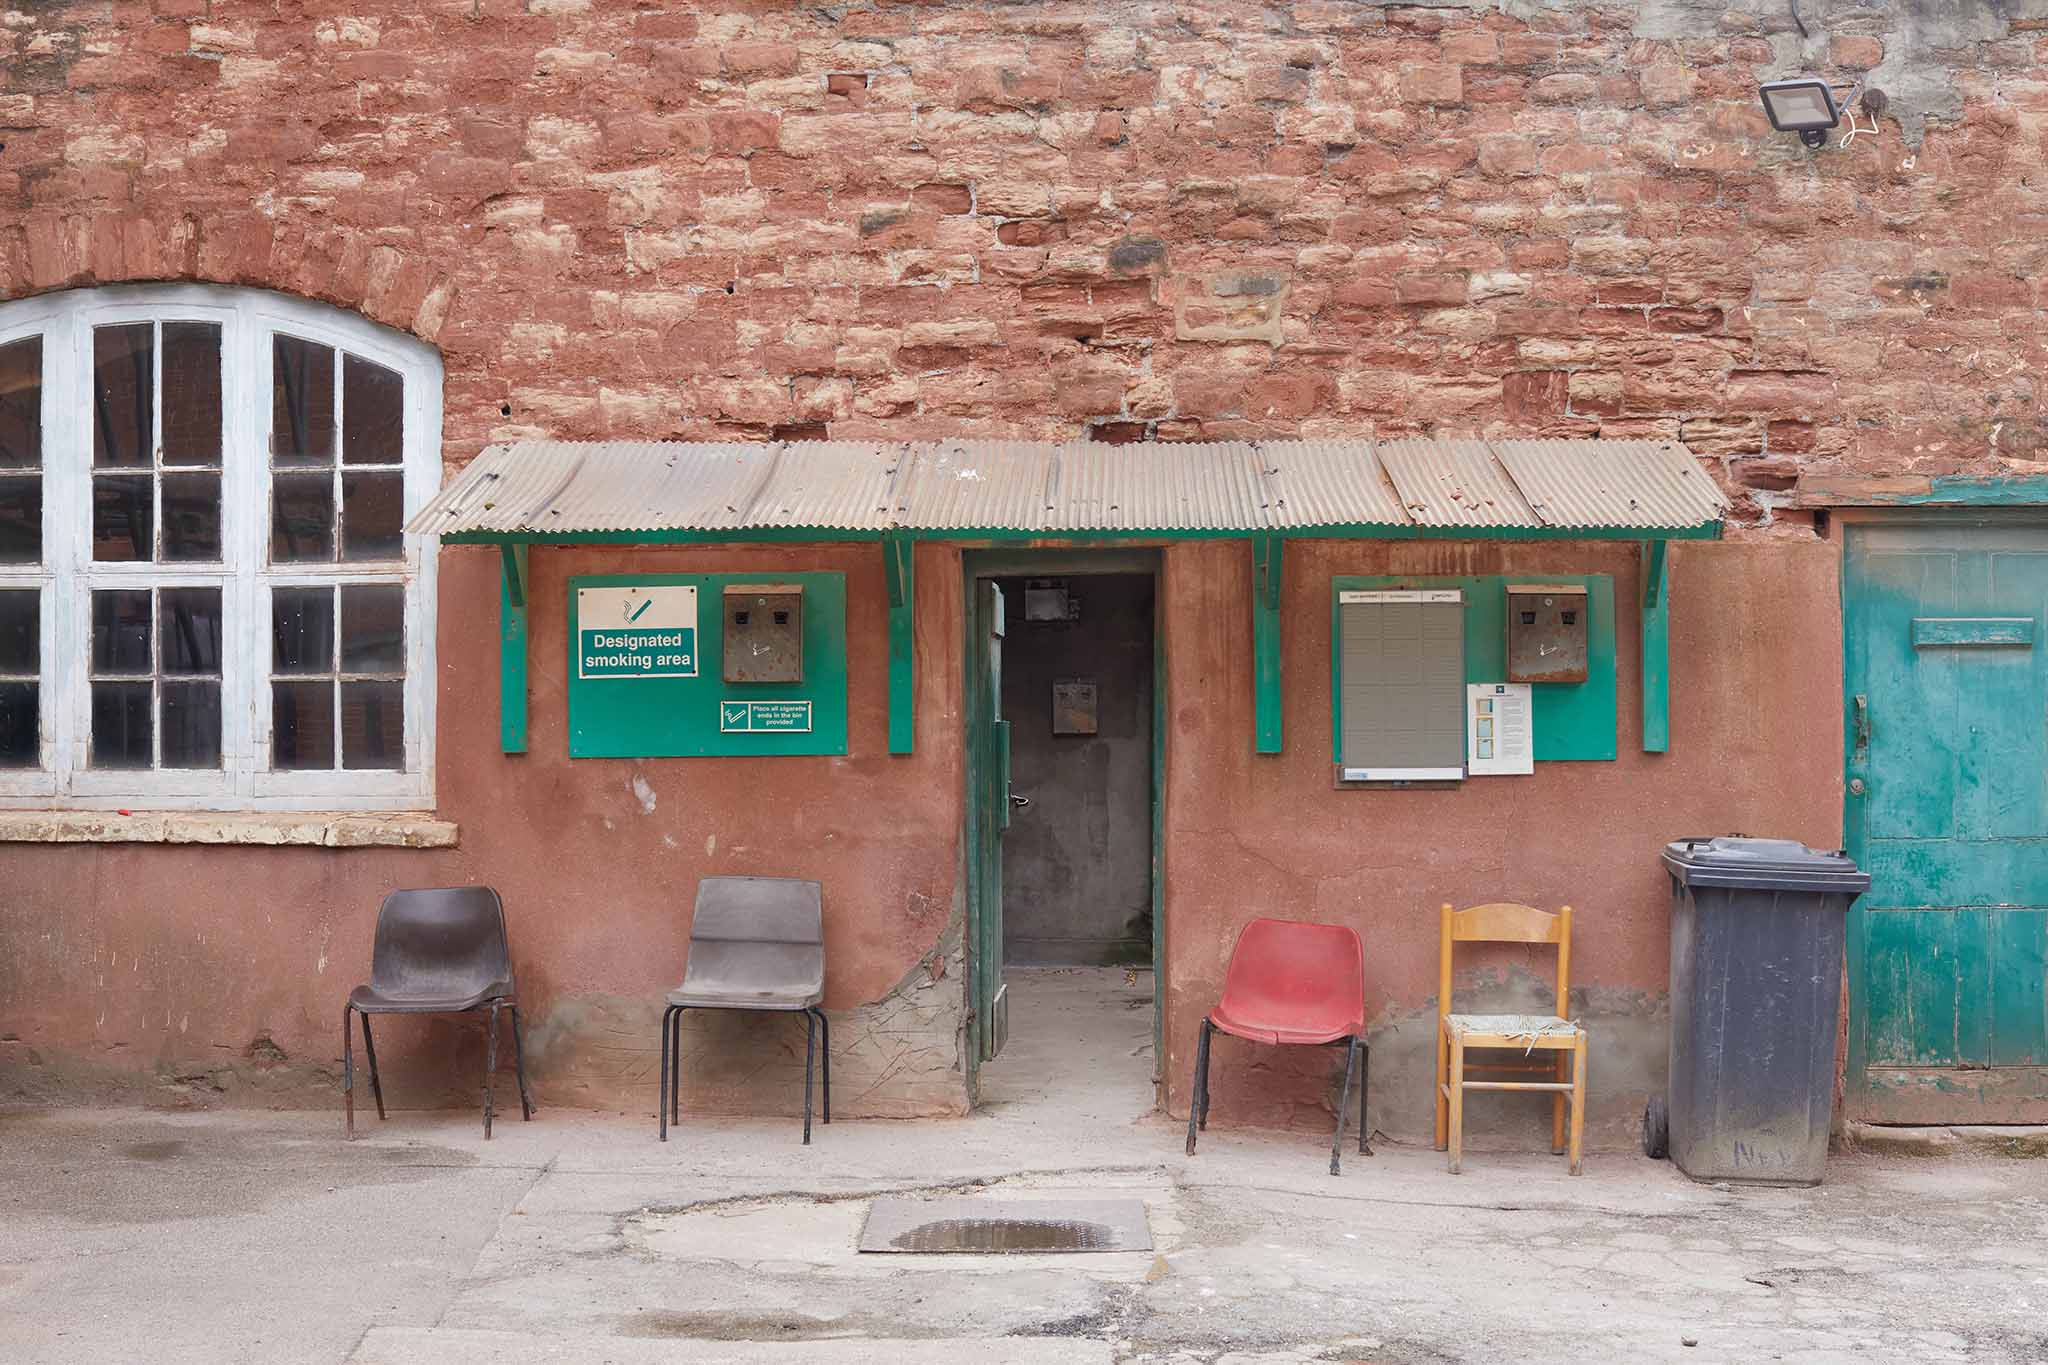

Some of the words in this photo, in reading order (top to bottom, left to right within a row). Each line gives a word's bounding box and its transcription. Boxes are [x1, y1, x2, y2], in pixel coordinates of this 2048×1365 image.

[594, 632, 682, 651] Designated
[585, 653, 652, 669] smoking
[656, 654, 691, 665] area
[780, 705, 807, 713] cigarette
